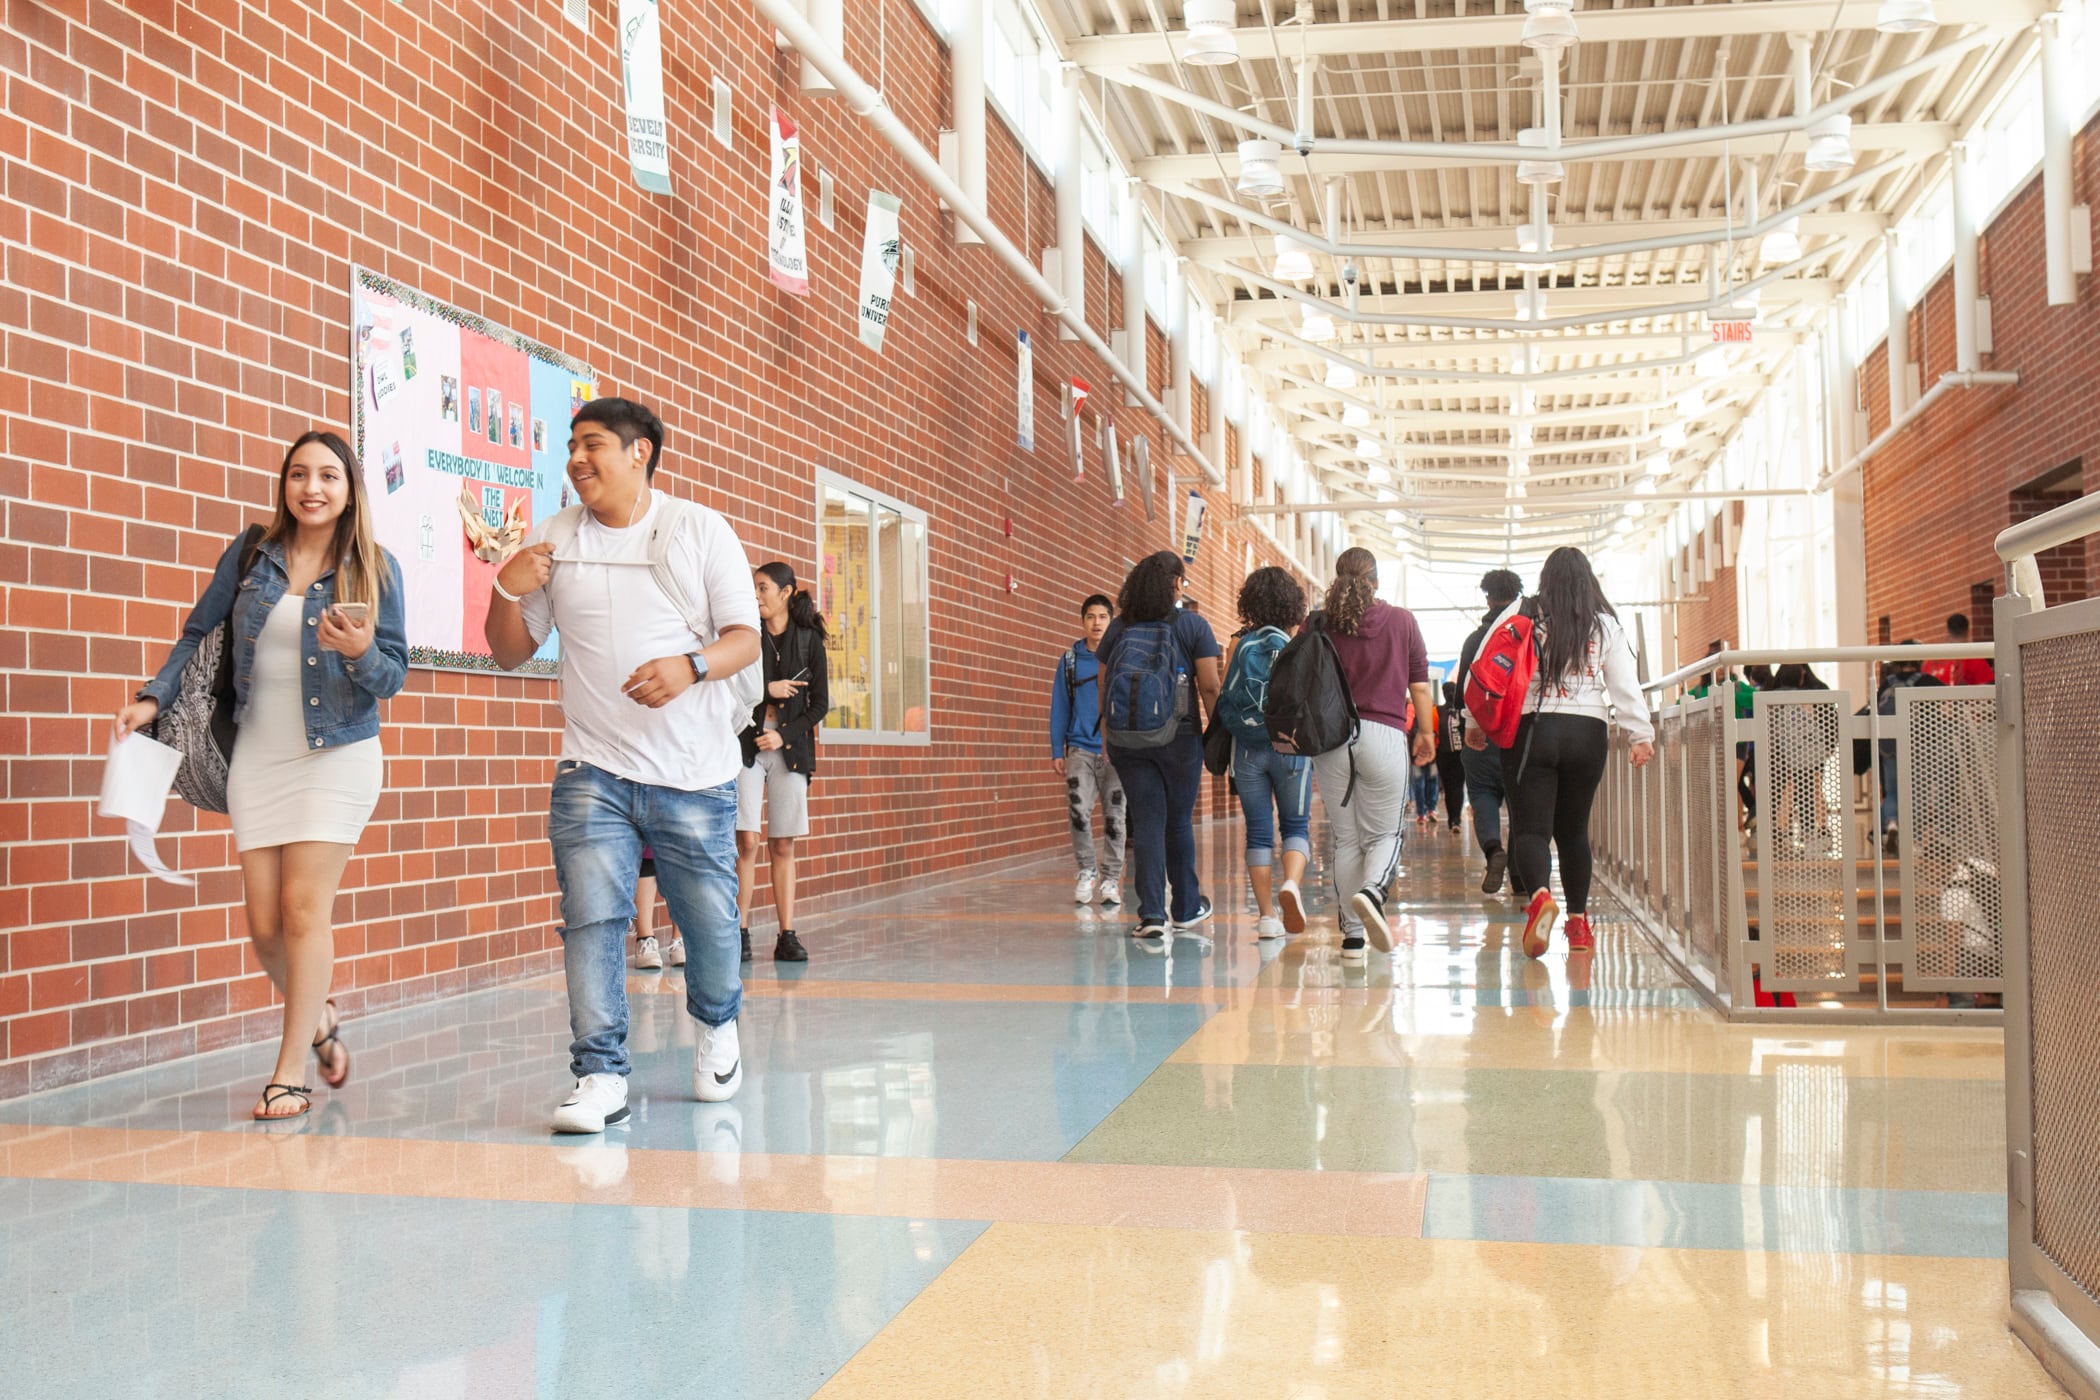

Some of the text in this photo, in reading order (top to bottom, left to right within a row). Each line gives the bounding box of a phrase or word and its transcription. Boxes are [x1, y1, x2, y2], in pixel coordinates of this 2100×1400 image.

[1712, 322, 1752, 342] STAIRS
[428, 448, 544, 490] EVERYBODY IS WELCOME IN
[485, 487, 500, 507] THE
[483, 508, 503, 528] NEST
